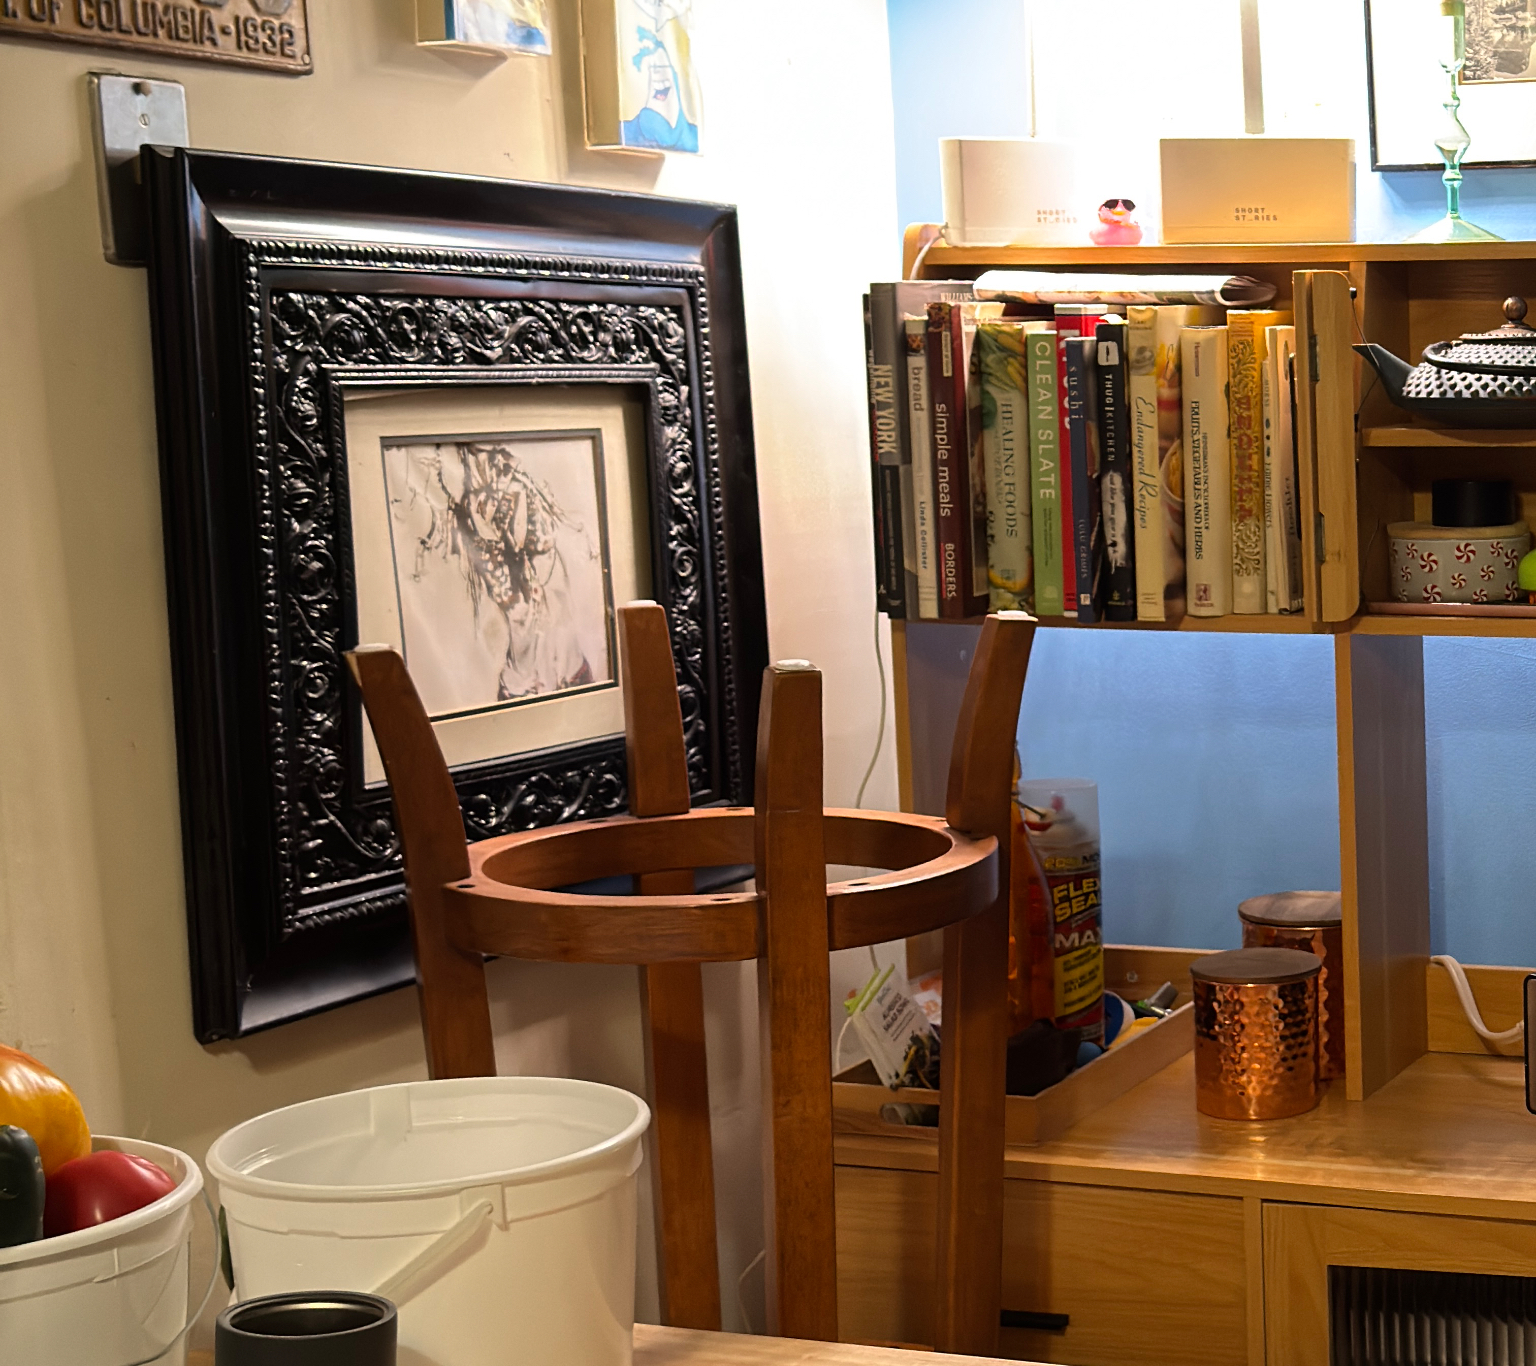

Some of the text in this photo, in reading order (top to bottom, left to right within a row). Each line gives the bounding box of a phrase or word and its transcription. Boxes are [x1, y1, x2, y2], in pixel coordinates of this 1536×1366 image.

[874, 363, 893, 404] NEW
[911, 366, 925, 412] bread
[1035, 341, 1054, 420] CLEAN
[1068, 365, 1083, 420] sushi
[877, 407, 897, 454] YORK
[1104, 373, 1116, 462] THUG KITCHEN
[934, 402, 954, 517] simple meals
[1000, 402, 1018, 539] HEALING FOODS
[1037, 428, 1056, 500] SLATE
[1134, 396, 1159, 530] Endangered Recipes
[1191, 439, 1203, 500] VEGETABLES
[918, 501, 928, 527] Linda
[1193, 502, 1204, 524] AND
[944, 542, 957, 598] BORDERS
[1193, 526, 1205, 561] HERBS
[1053, 877, 1099, 904] FLE
